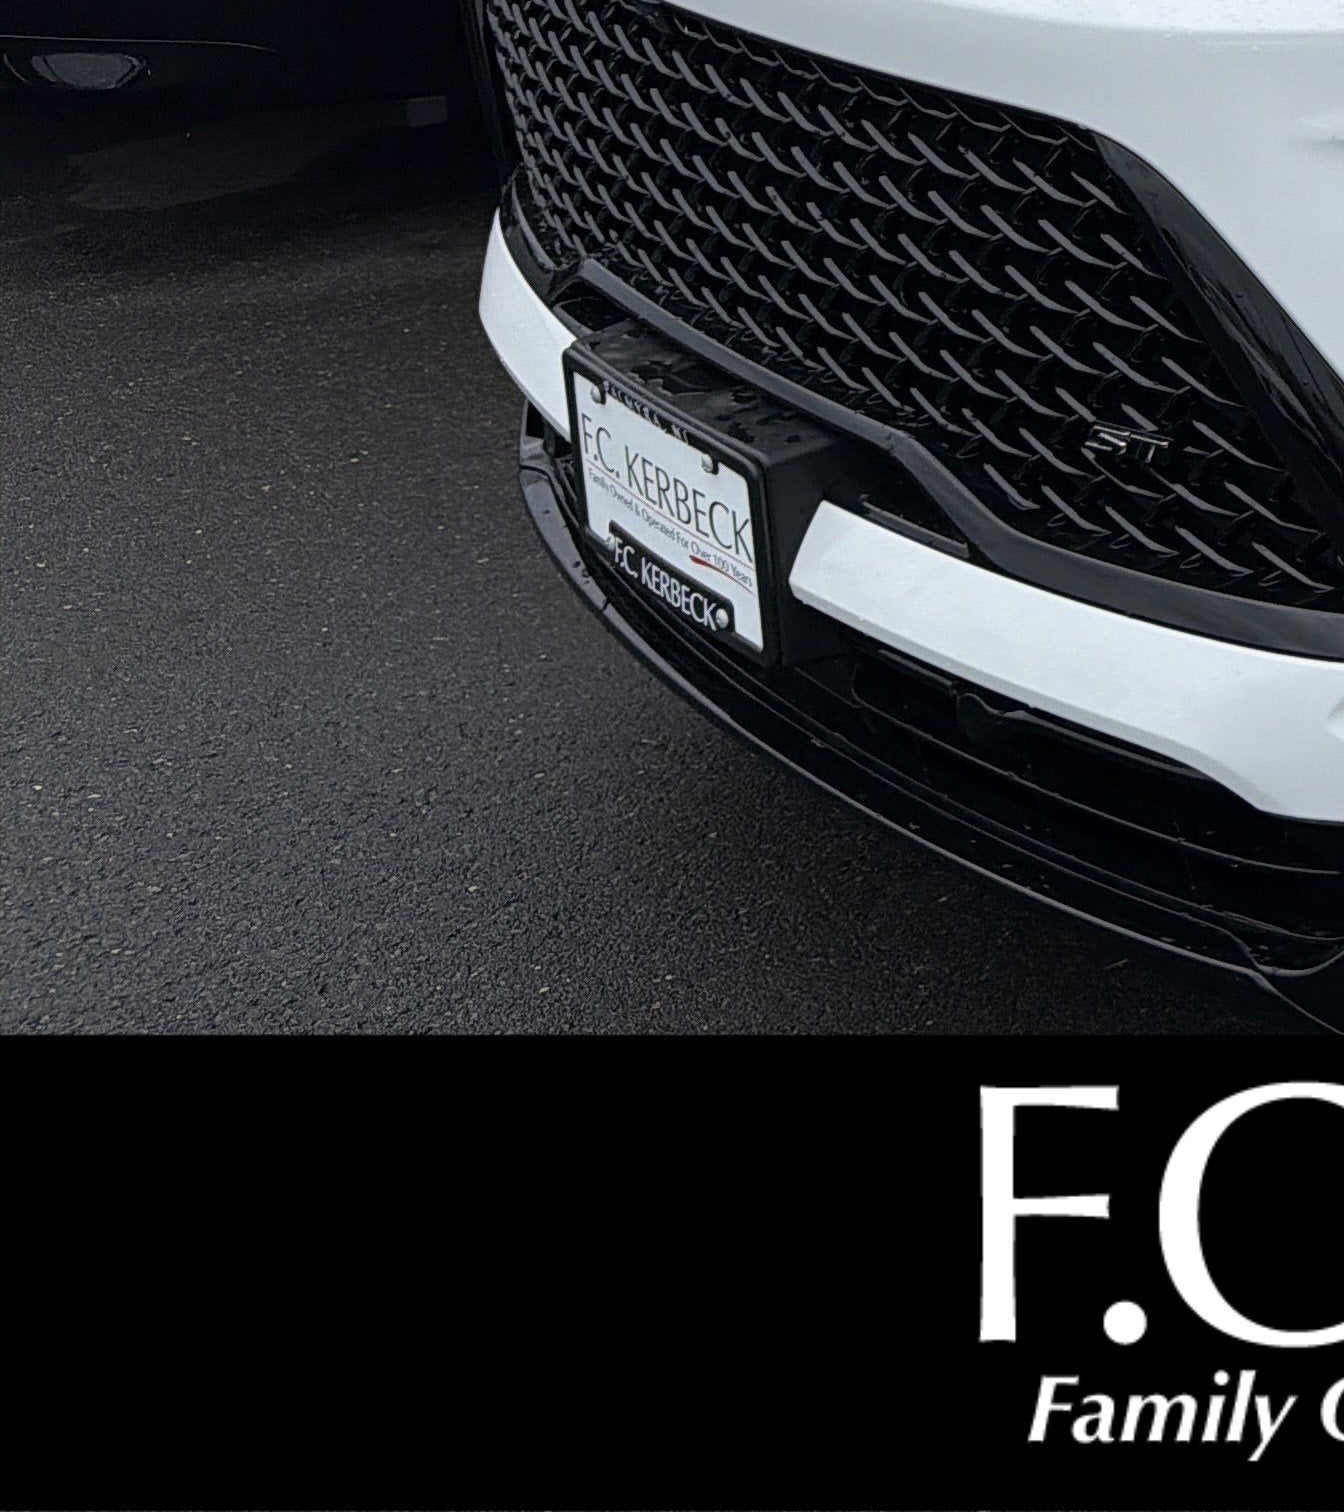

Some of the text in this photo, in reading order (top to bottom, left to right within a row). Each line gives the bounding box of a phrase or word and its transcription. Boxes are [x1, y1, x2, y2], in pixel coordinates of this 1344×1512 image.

[581, 412, 620, 478] F.C.
[624, 444, 755, 565] KERBECK
[614, 536, 718, 632] F.C. KERBECK
